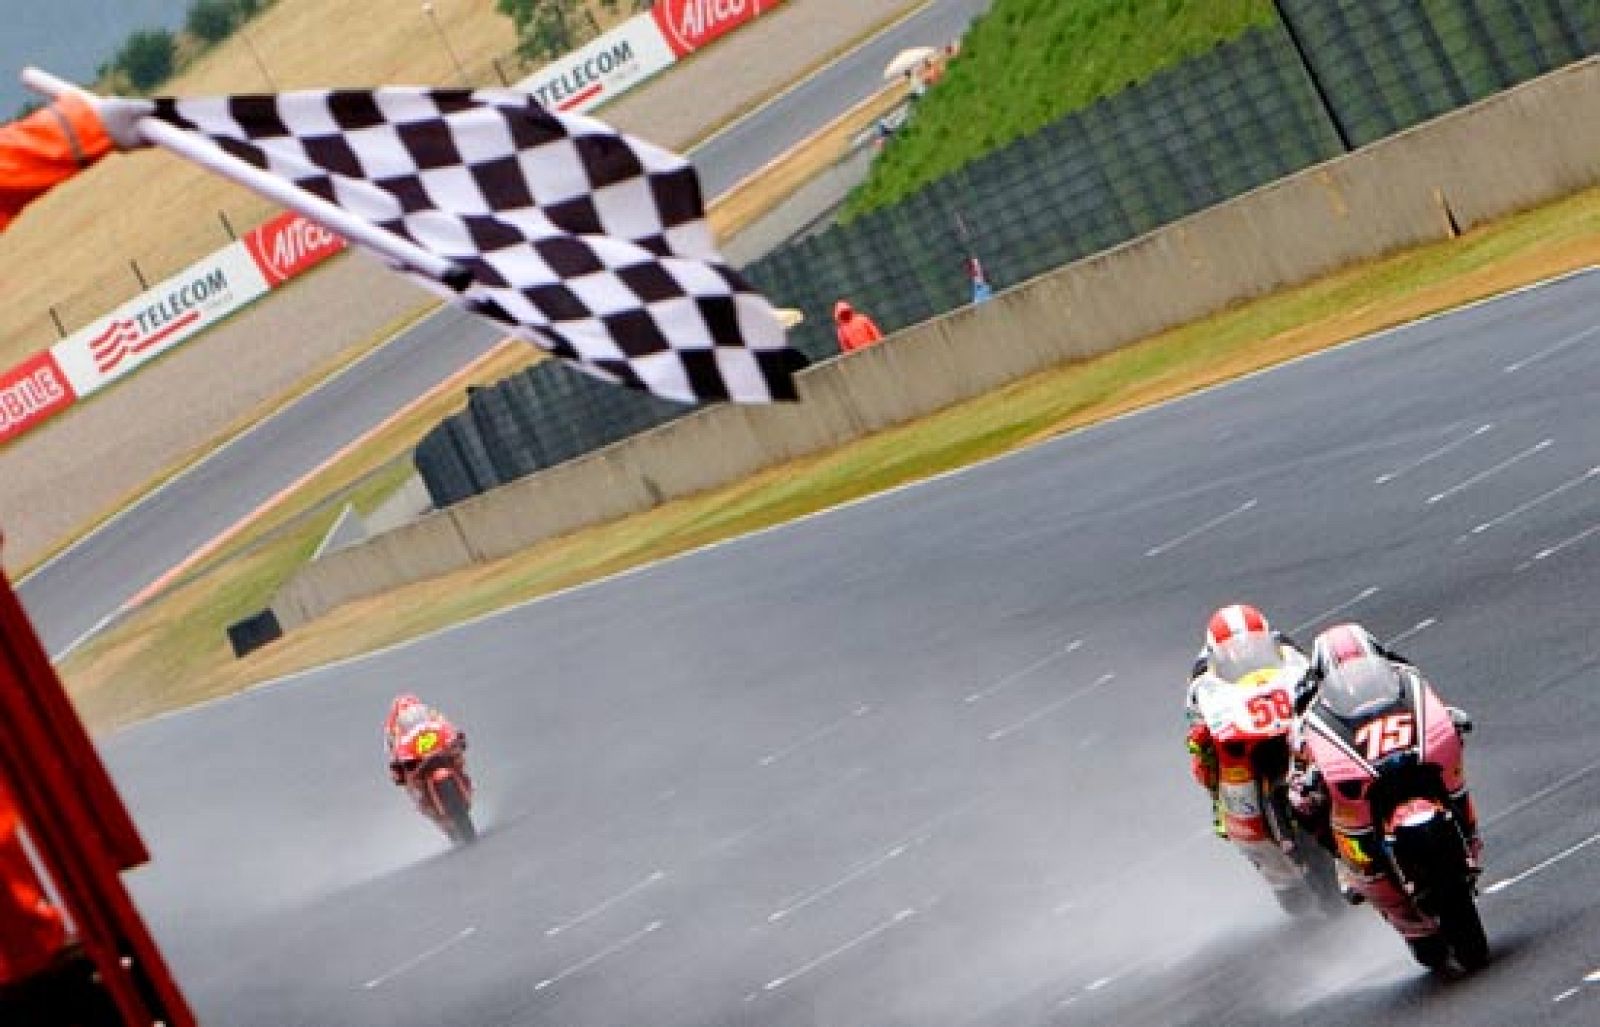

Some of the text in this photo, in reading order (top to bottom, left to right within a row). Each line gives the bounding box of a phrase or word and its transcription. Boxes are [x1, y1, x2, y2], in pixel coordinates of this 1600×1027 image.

[536, 40, 635, 105] TELECOM
[135, 267, 228, 333] TELECOM
[1247, 688, 1291, 728] 58
